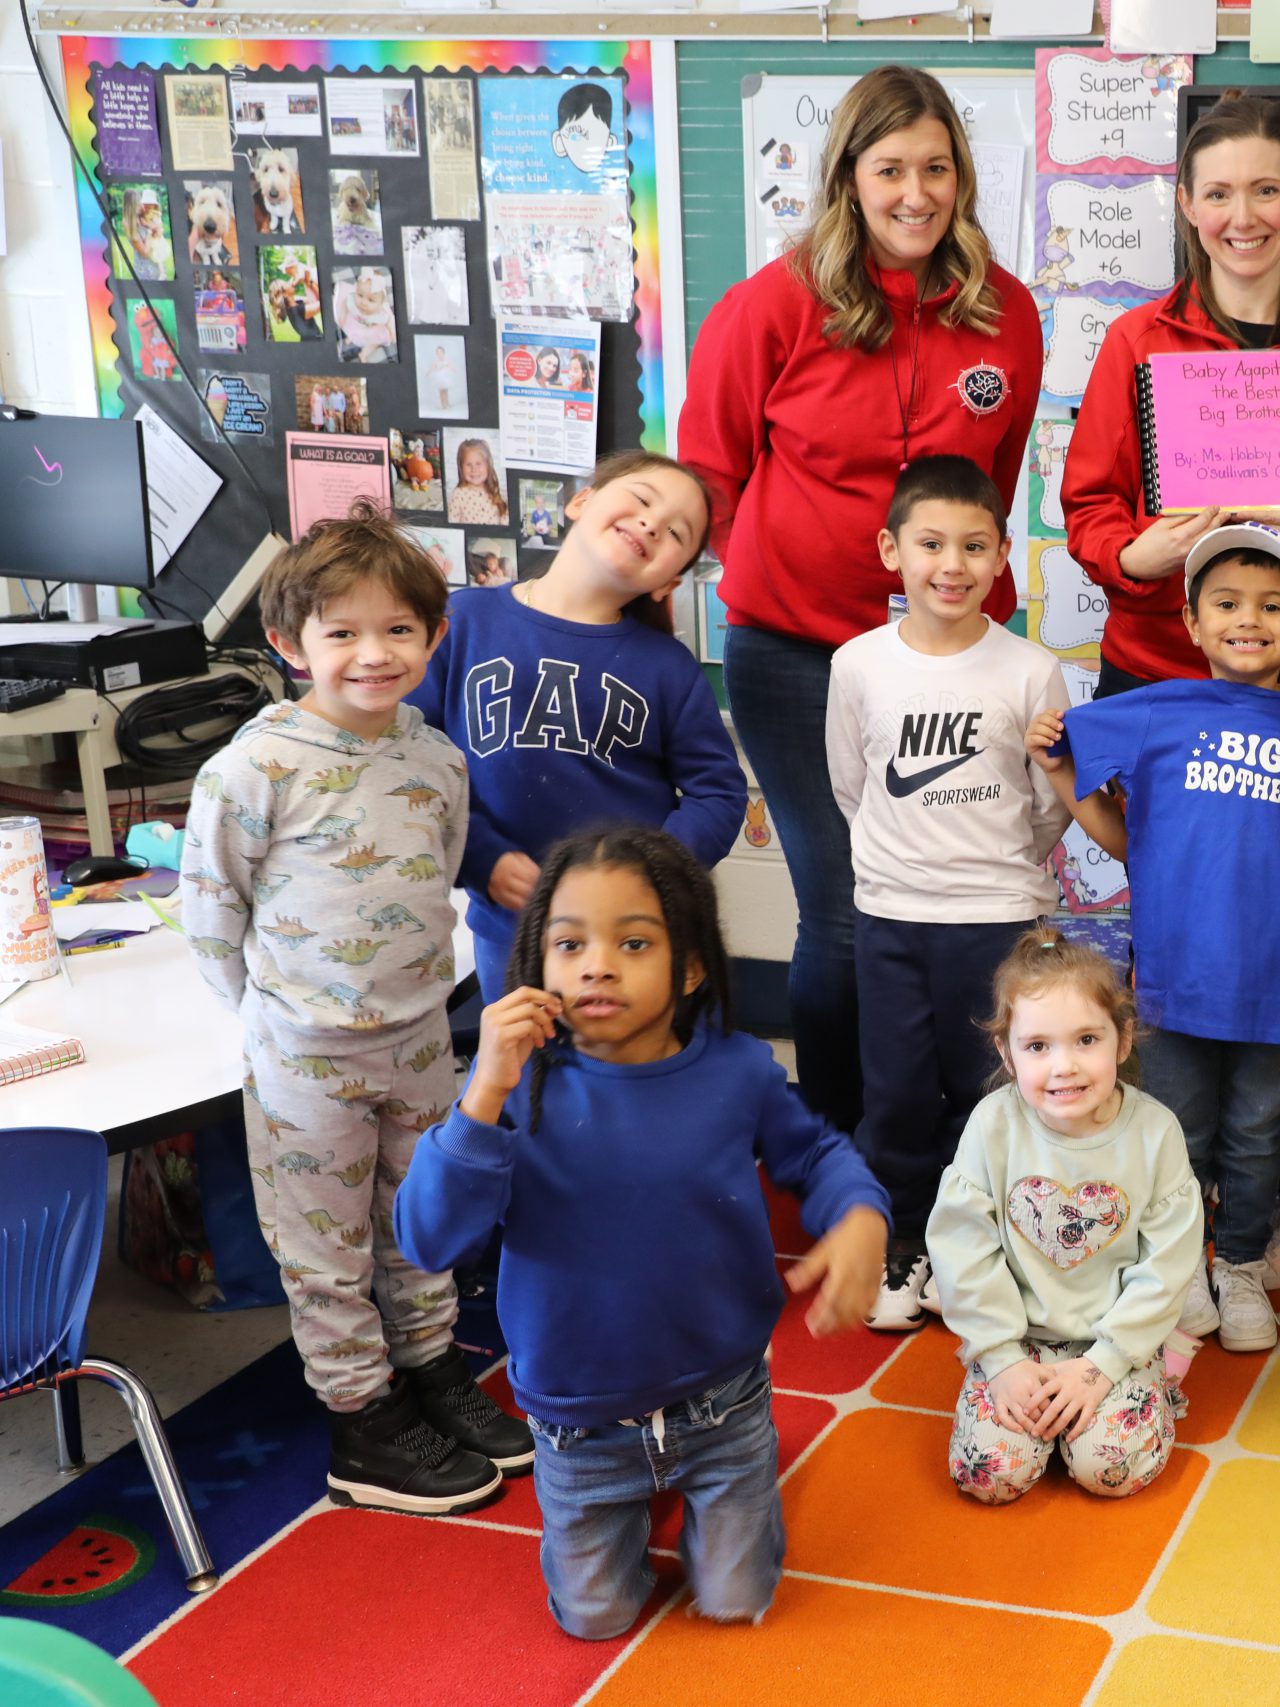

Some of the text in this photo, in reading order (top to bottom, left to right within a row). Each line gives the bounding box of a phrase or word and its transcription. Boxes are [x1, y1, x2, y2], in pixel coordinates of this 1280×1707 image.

[1079, 72, 1144, 98] Super
[795, 95, 836, 128] Ou
[1067, 100, 1157, 122] Student
[1100, 128, 1124, 149] +9
[1088, 201, 1132, 221] Role
[1079, 229, 1141, 249] Model
[1098, 256, 1122, 276] +6
[1080, 313, 1111, 335] Gr
[1182, 362, 1227, 381] Baby
[1211, 382, 1280, 400] the Best
[1199, 405, 1225, 427] Big
[299, 448, 375, 463] WHAT IS A GOAL?
[1174, 451, 1198, 468] By:
[1202, 449, 1226, 463] Ms.
[1230, 446, 1272, 464] Hobby
[1077, 593, 1110, 613] Do
[464, 656, 650, 769] GAP
[898, 712, 983, 758] NIKE
[922, 784, 1001, 807] SPORTSWEAR
[1086, 847, 1111, 865] Co
